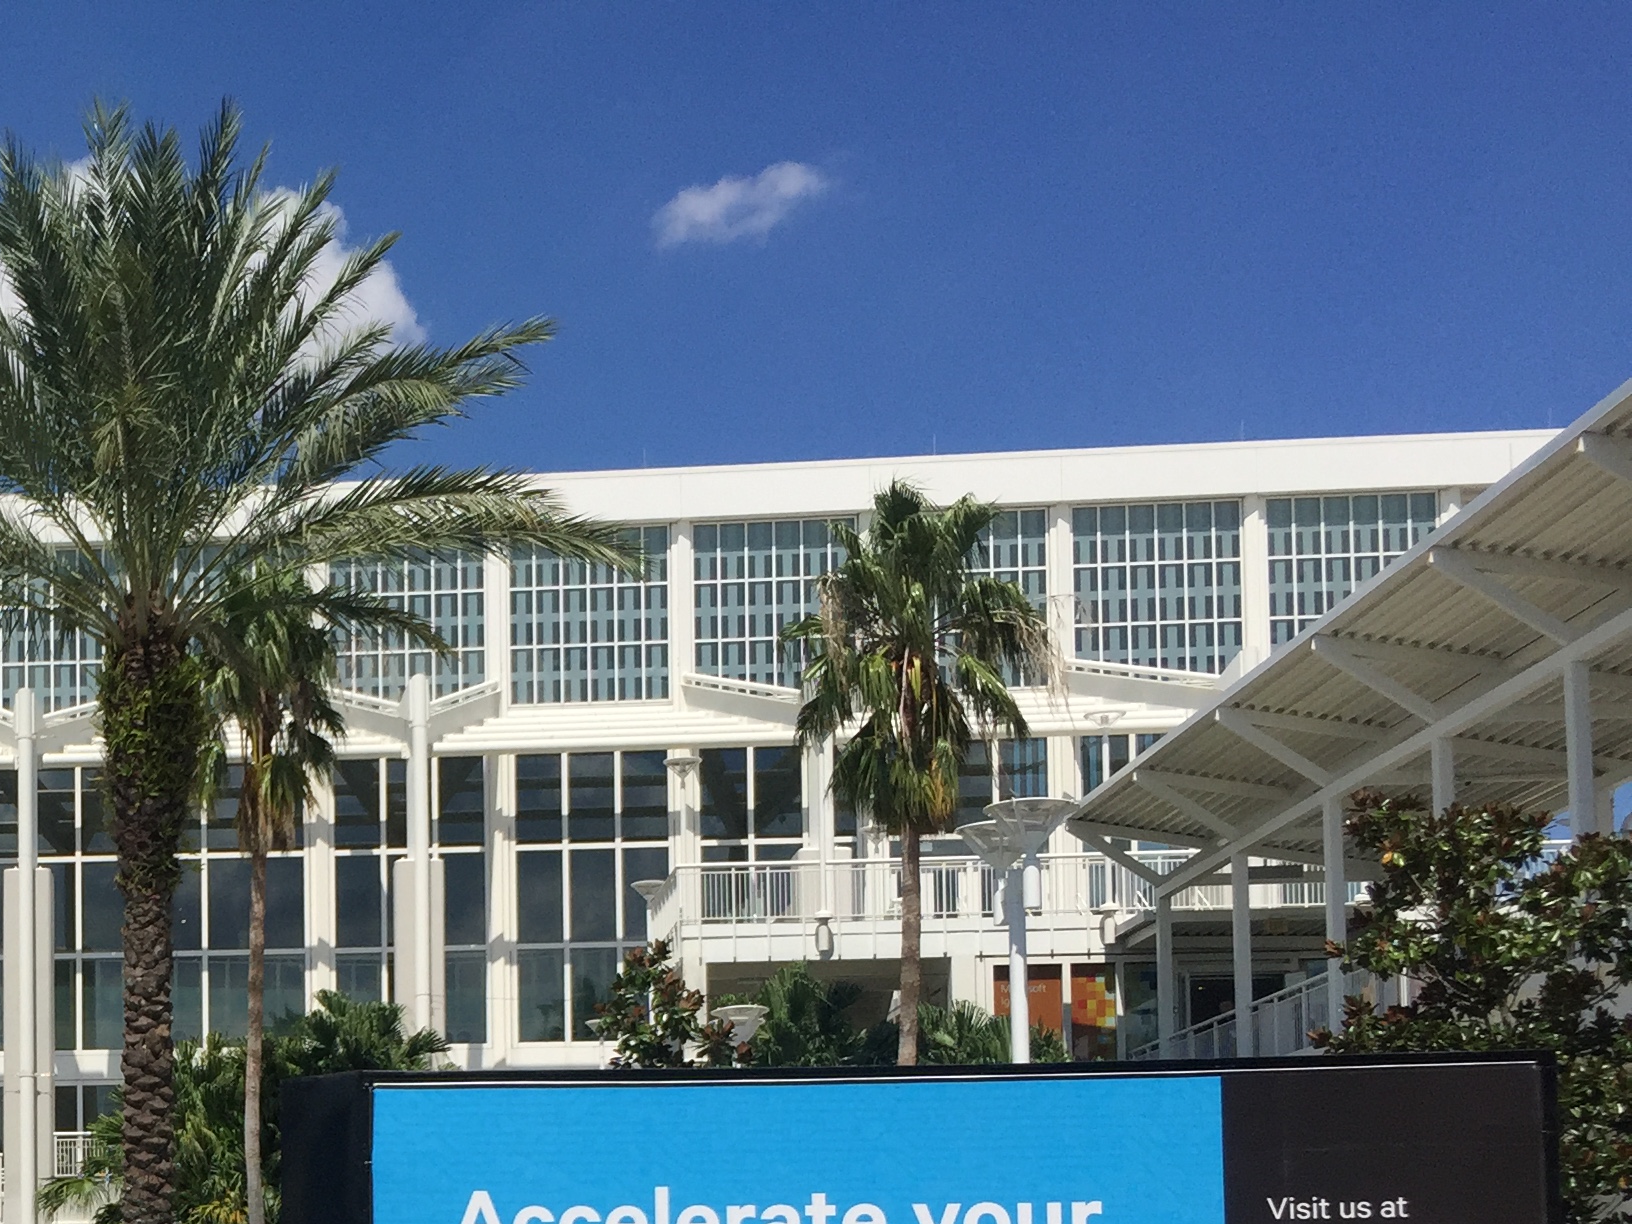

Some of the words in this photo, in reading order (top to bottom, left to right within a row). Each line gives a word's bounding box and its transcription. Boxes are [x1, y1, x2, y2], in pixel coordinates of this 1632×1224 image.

[1266, 1196, 1331, 1220] Visit
[1339, 1201, 1372, 1219] us
[1380, 1196, 1409, 1219] at
